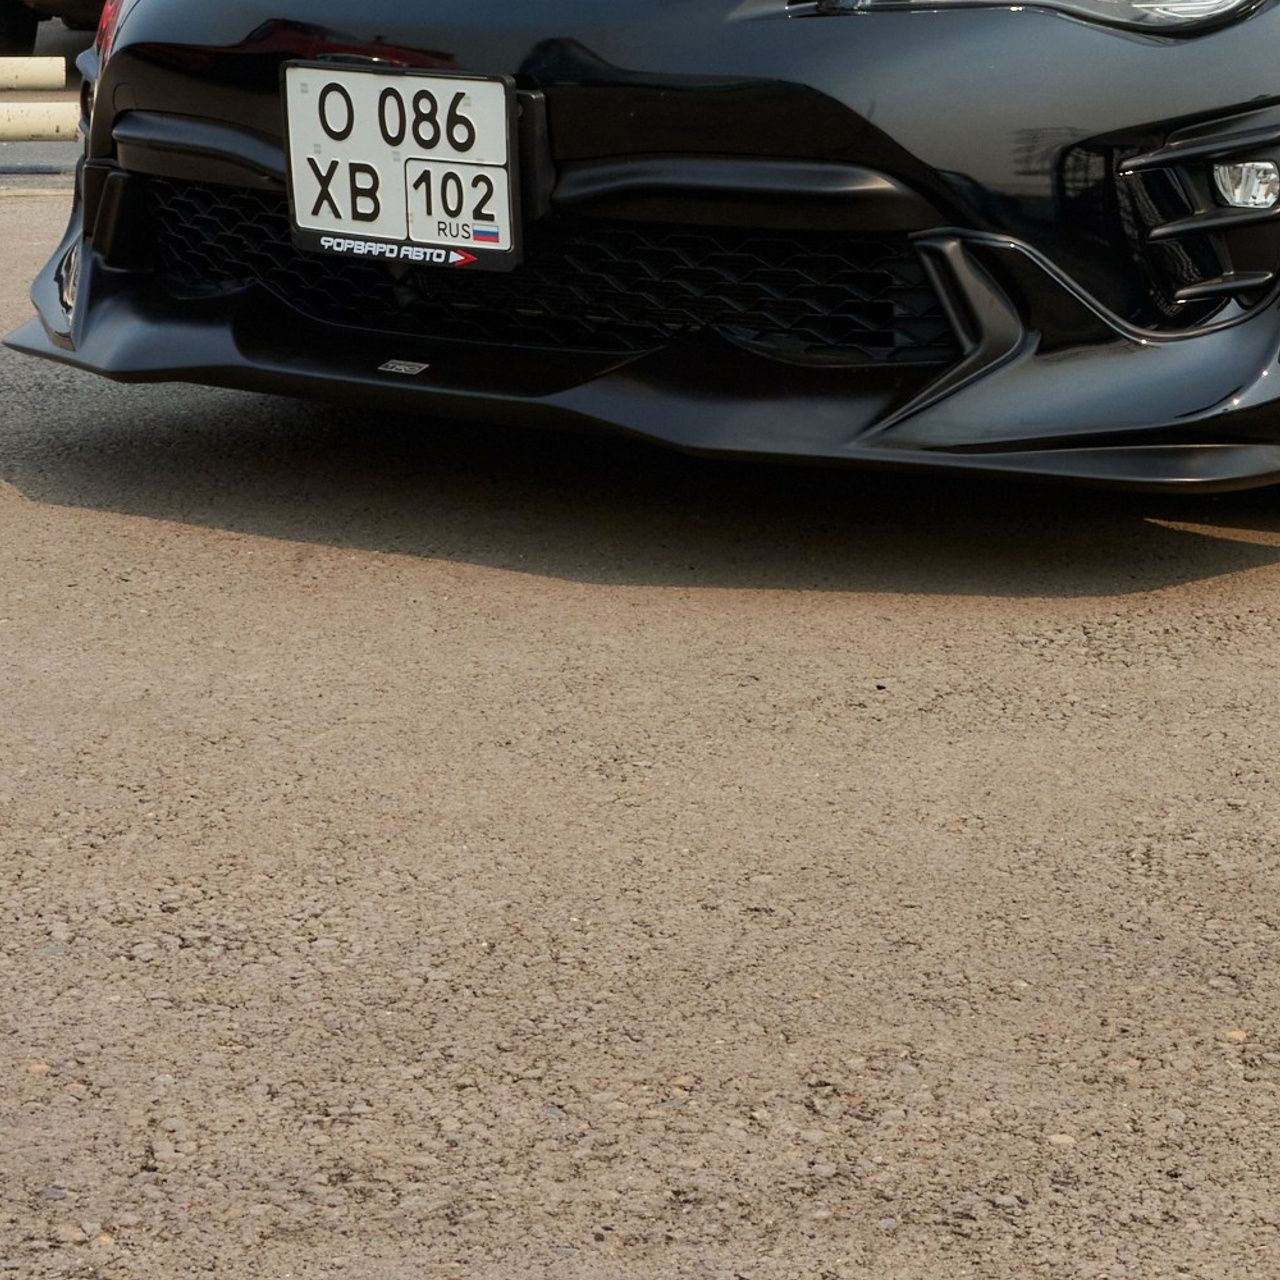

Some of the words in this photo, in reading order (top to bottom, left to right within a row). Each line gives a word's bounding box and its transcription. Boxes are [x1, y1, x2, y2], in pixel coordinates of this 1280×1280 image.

[378, 86, 476, 153] 086
[413, 170, 496, 222] 102
[437, 221, 471, 238] RUS
